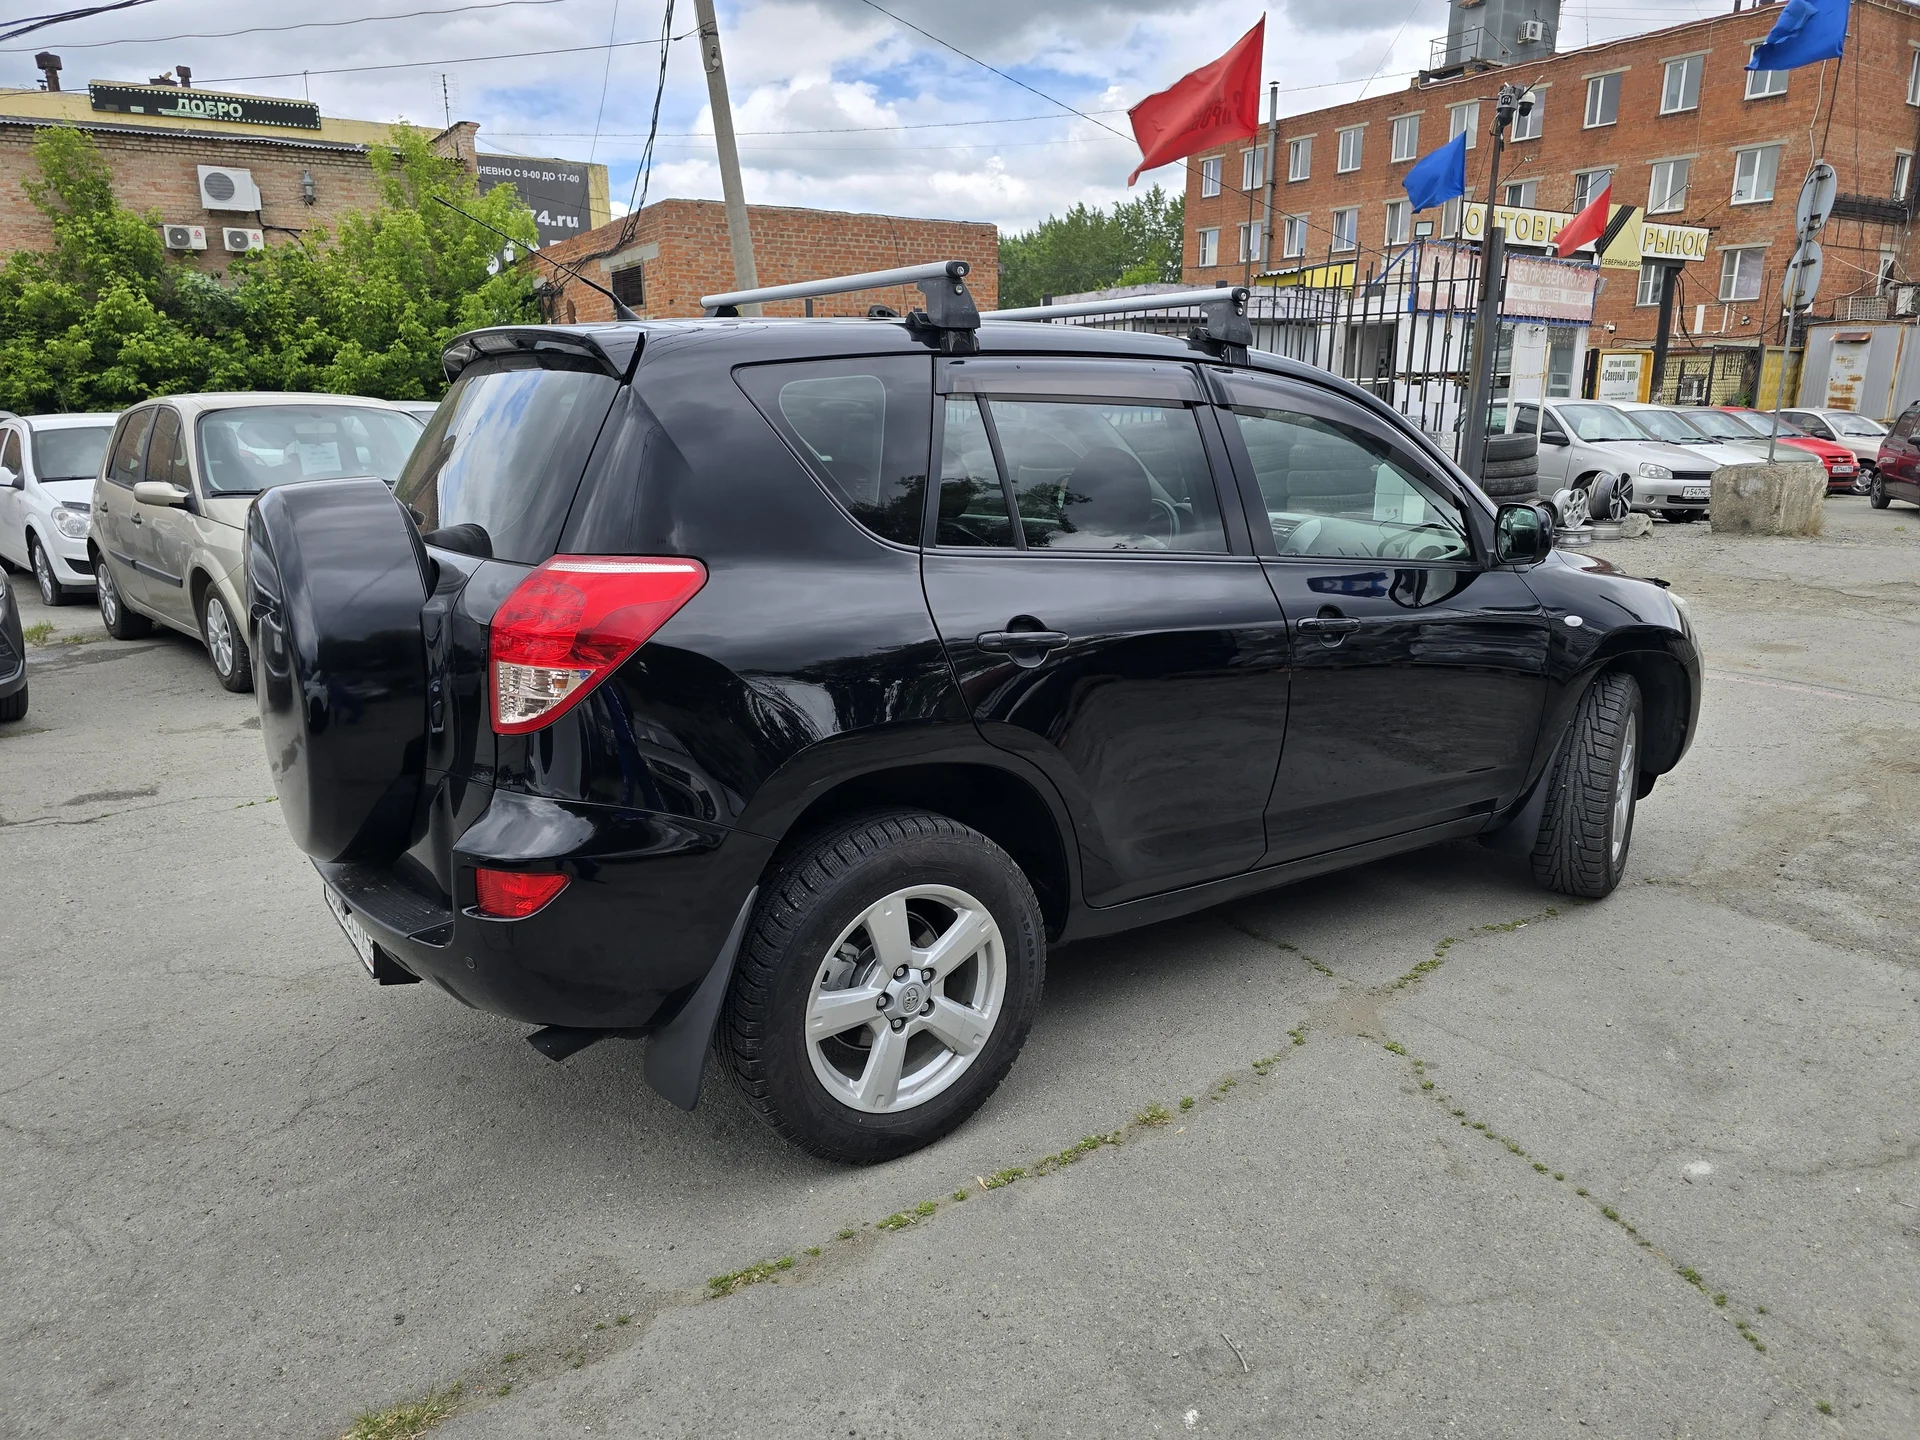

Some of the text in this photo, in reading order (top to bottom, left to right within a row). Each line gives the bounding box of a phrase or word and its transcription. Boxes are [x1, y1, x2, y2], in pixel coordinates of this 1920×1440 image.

[176, 98, 243, 118] ДОБРО
[522, 170, 540, 179] 9-00
[542, 172, 555, 181] ДО
[558, 173, 579, 183] 17-00
[1643, 228, 1707, 256] РЫНОК
[1602, 258, 1641, 268] СЕВЕРНЫЙ ДВОР
[1513, 265, 1529, 280] БЕЗ
[1576, 273, 1589, 289] РФ
